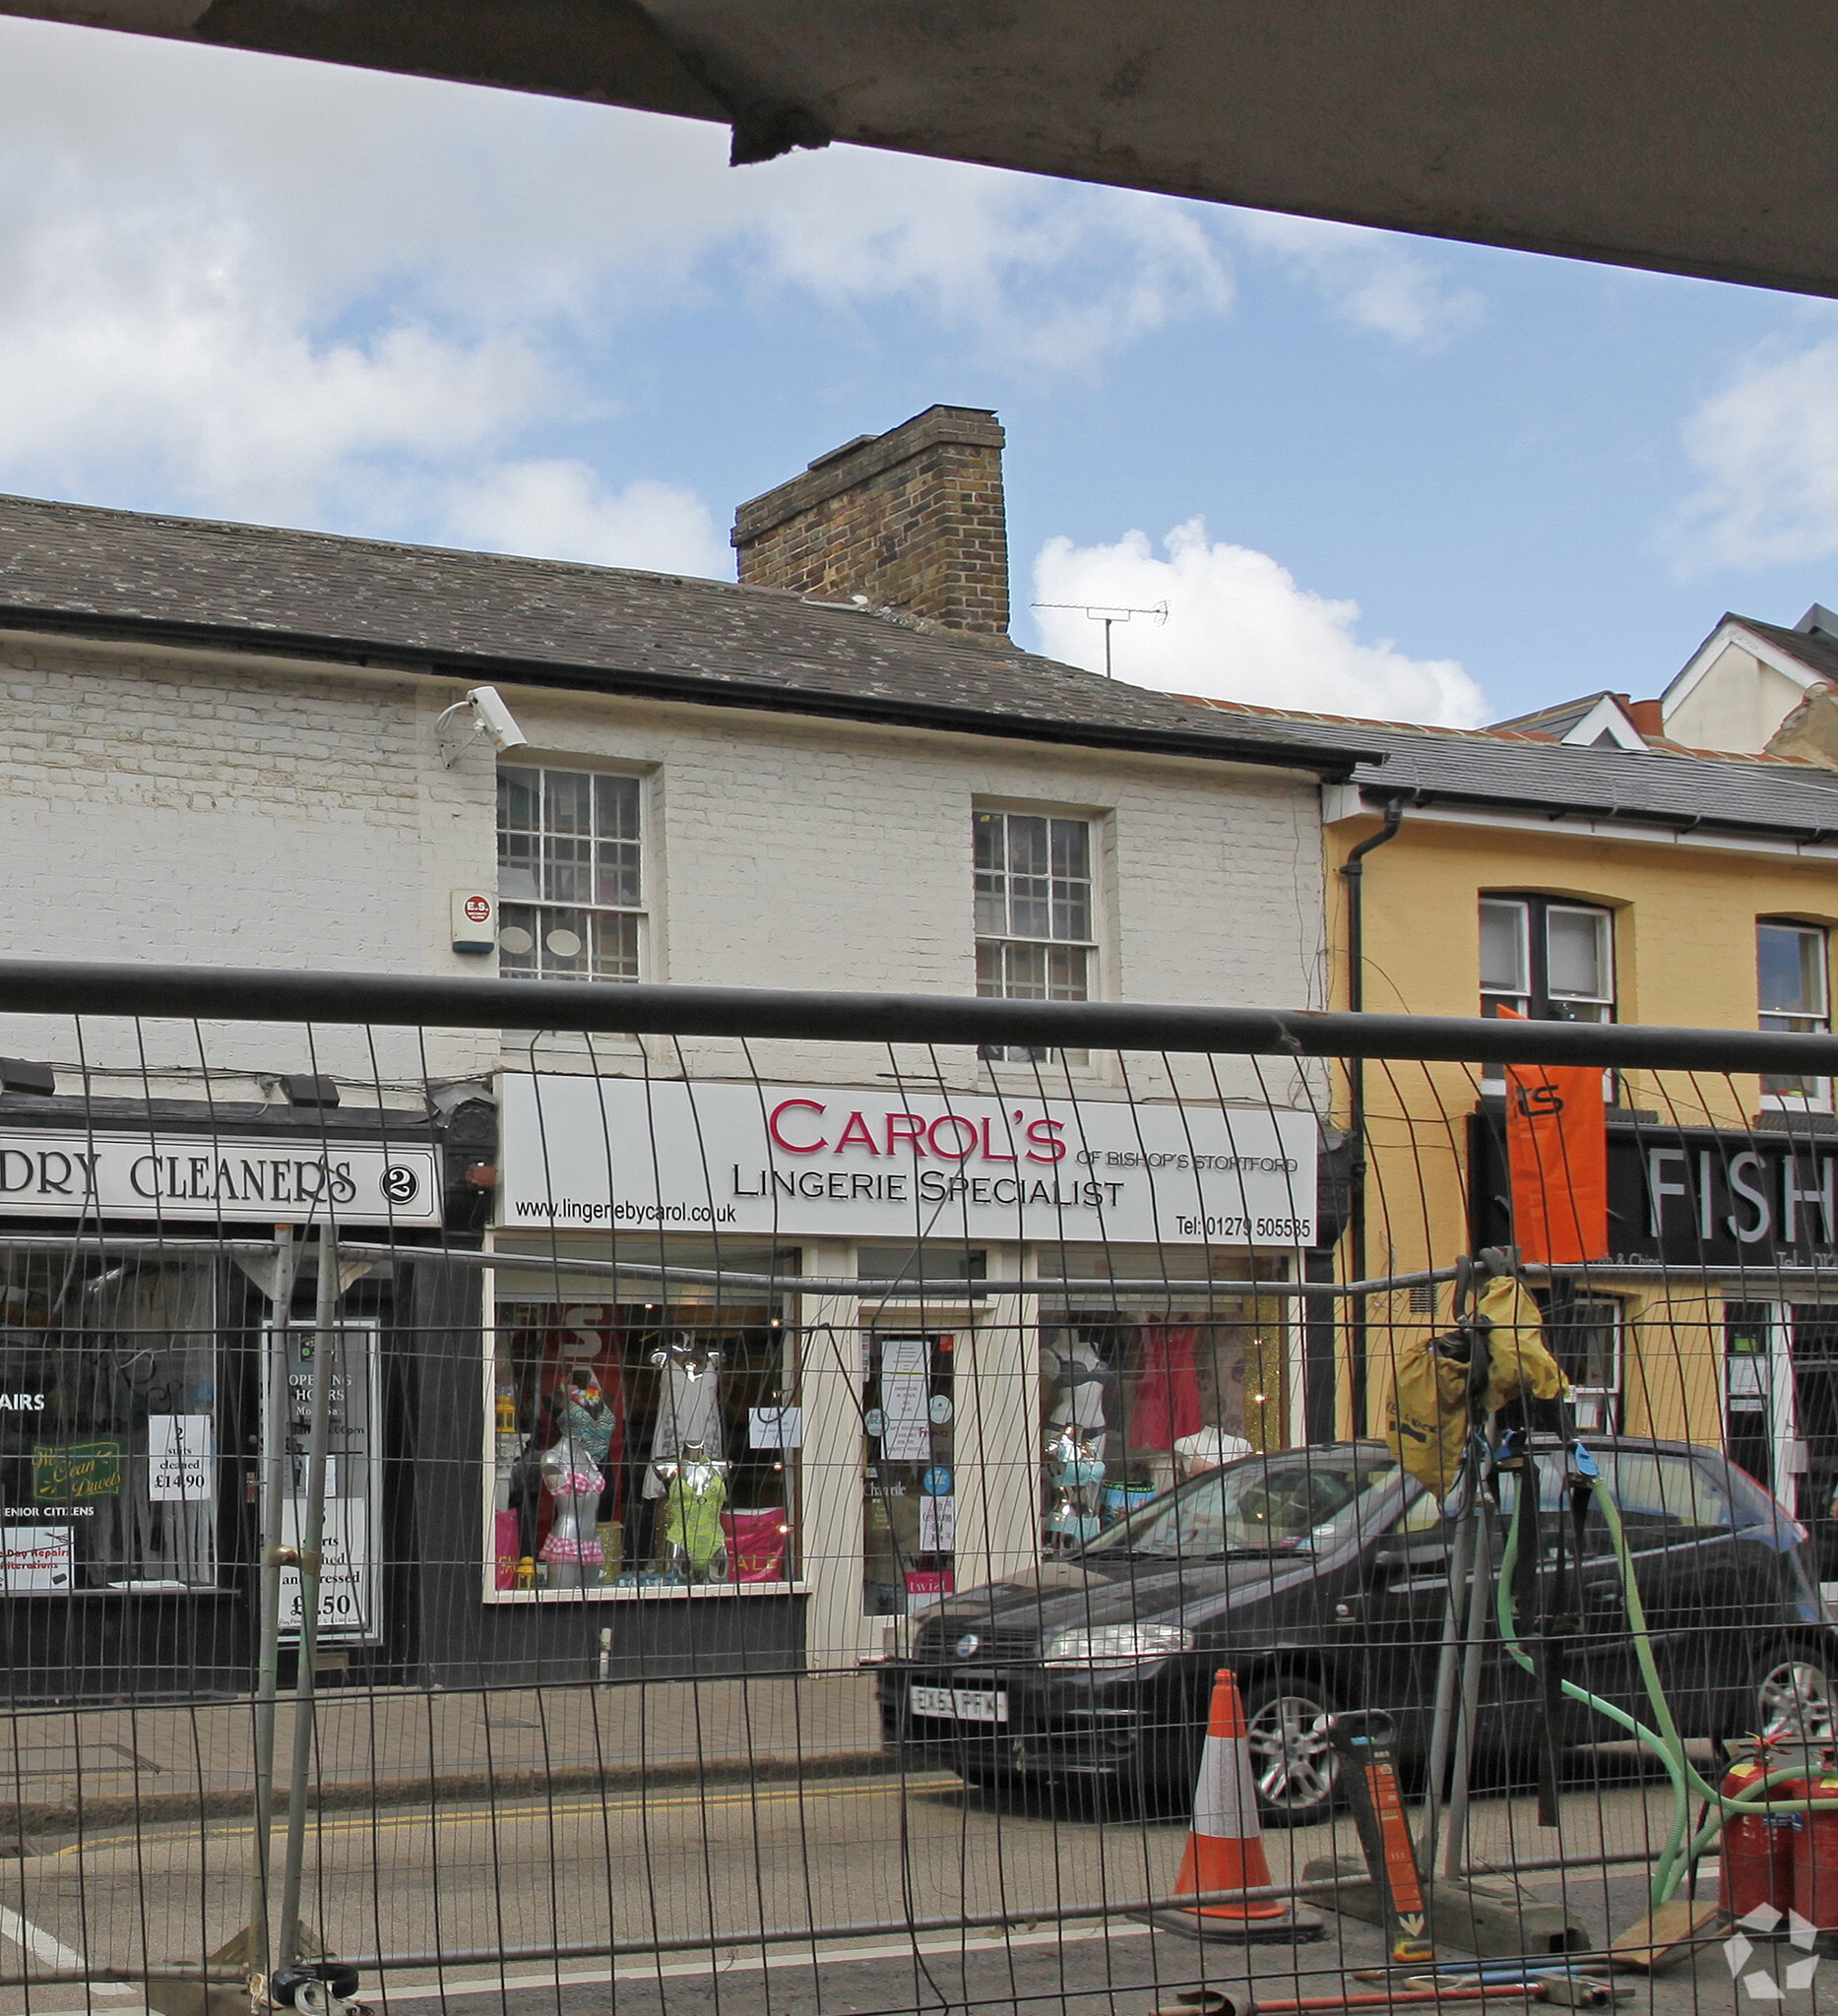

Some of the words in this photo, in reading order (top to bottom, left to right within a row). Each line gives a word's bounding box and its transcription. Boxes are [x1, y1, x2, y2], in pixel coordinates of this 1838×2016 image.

[769, 1098, 1066, 1164] CAROL'S
[1076, 1150, 1103, 1166] OF
[1107, 1151, 1189, 1169] BISHOP'S
[1193, 1155, 1299, 1172] STORTFORD
[0, 1149, 101, 1194] DRY
[129, 1154, 356, 1203] CLEANERS
[732, 1164, 908, 1202] LINGERIE
[919, 1169, 1124, 1207] SPECIALIST
[1648, 1148, 1834, 1243] FISH
[516, 1198, 736, 1225] www.lingerebycarol.co.uk
[1175, 1216, 1201, 1235] Tel:
[1207, 1216, 1251, 1236] 01279
